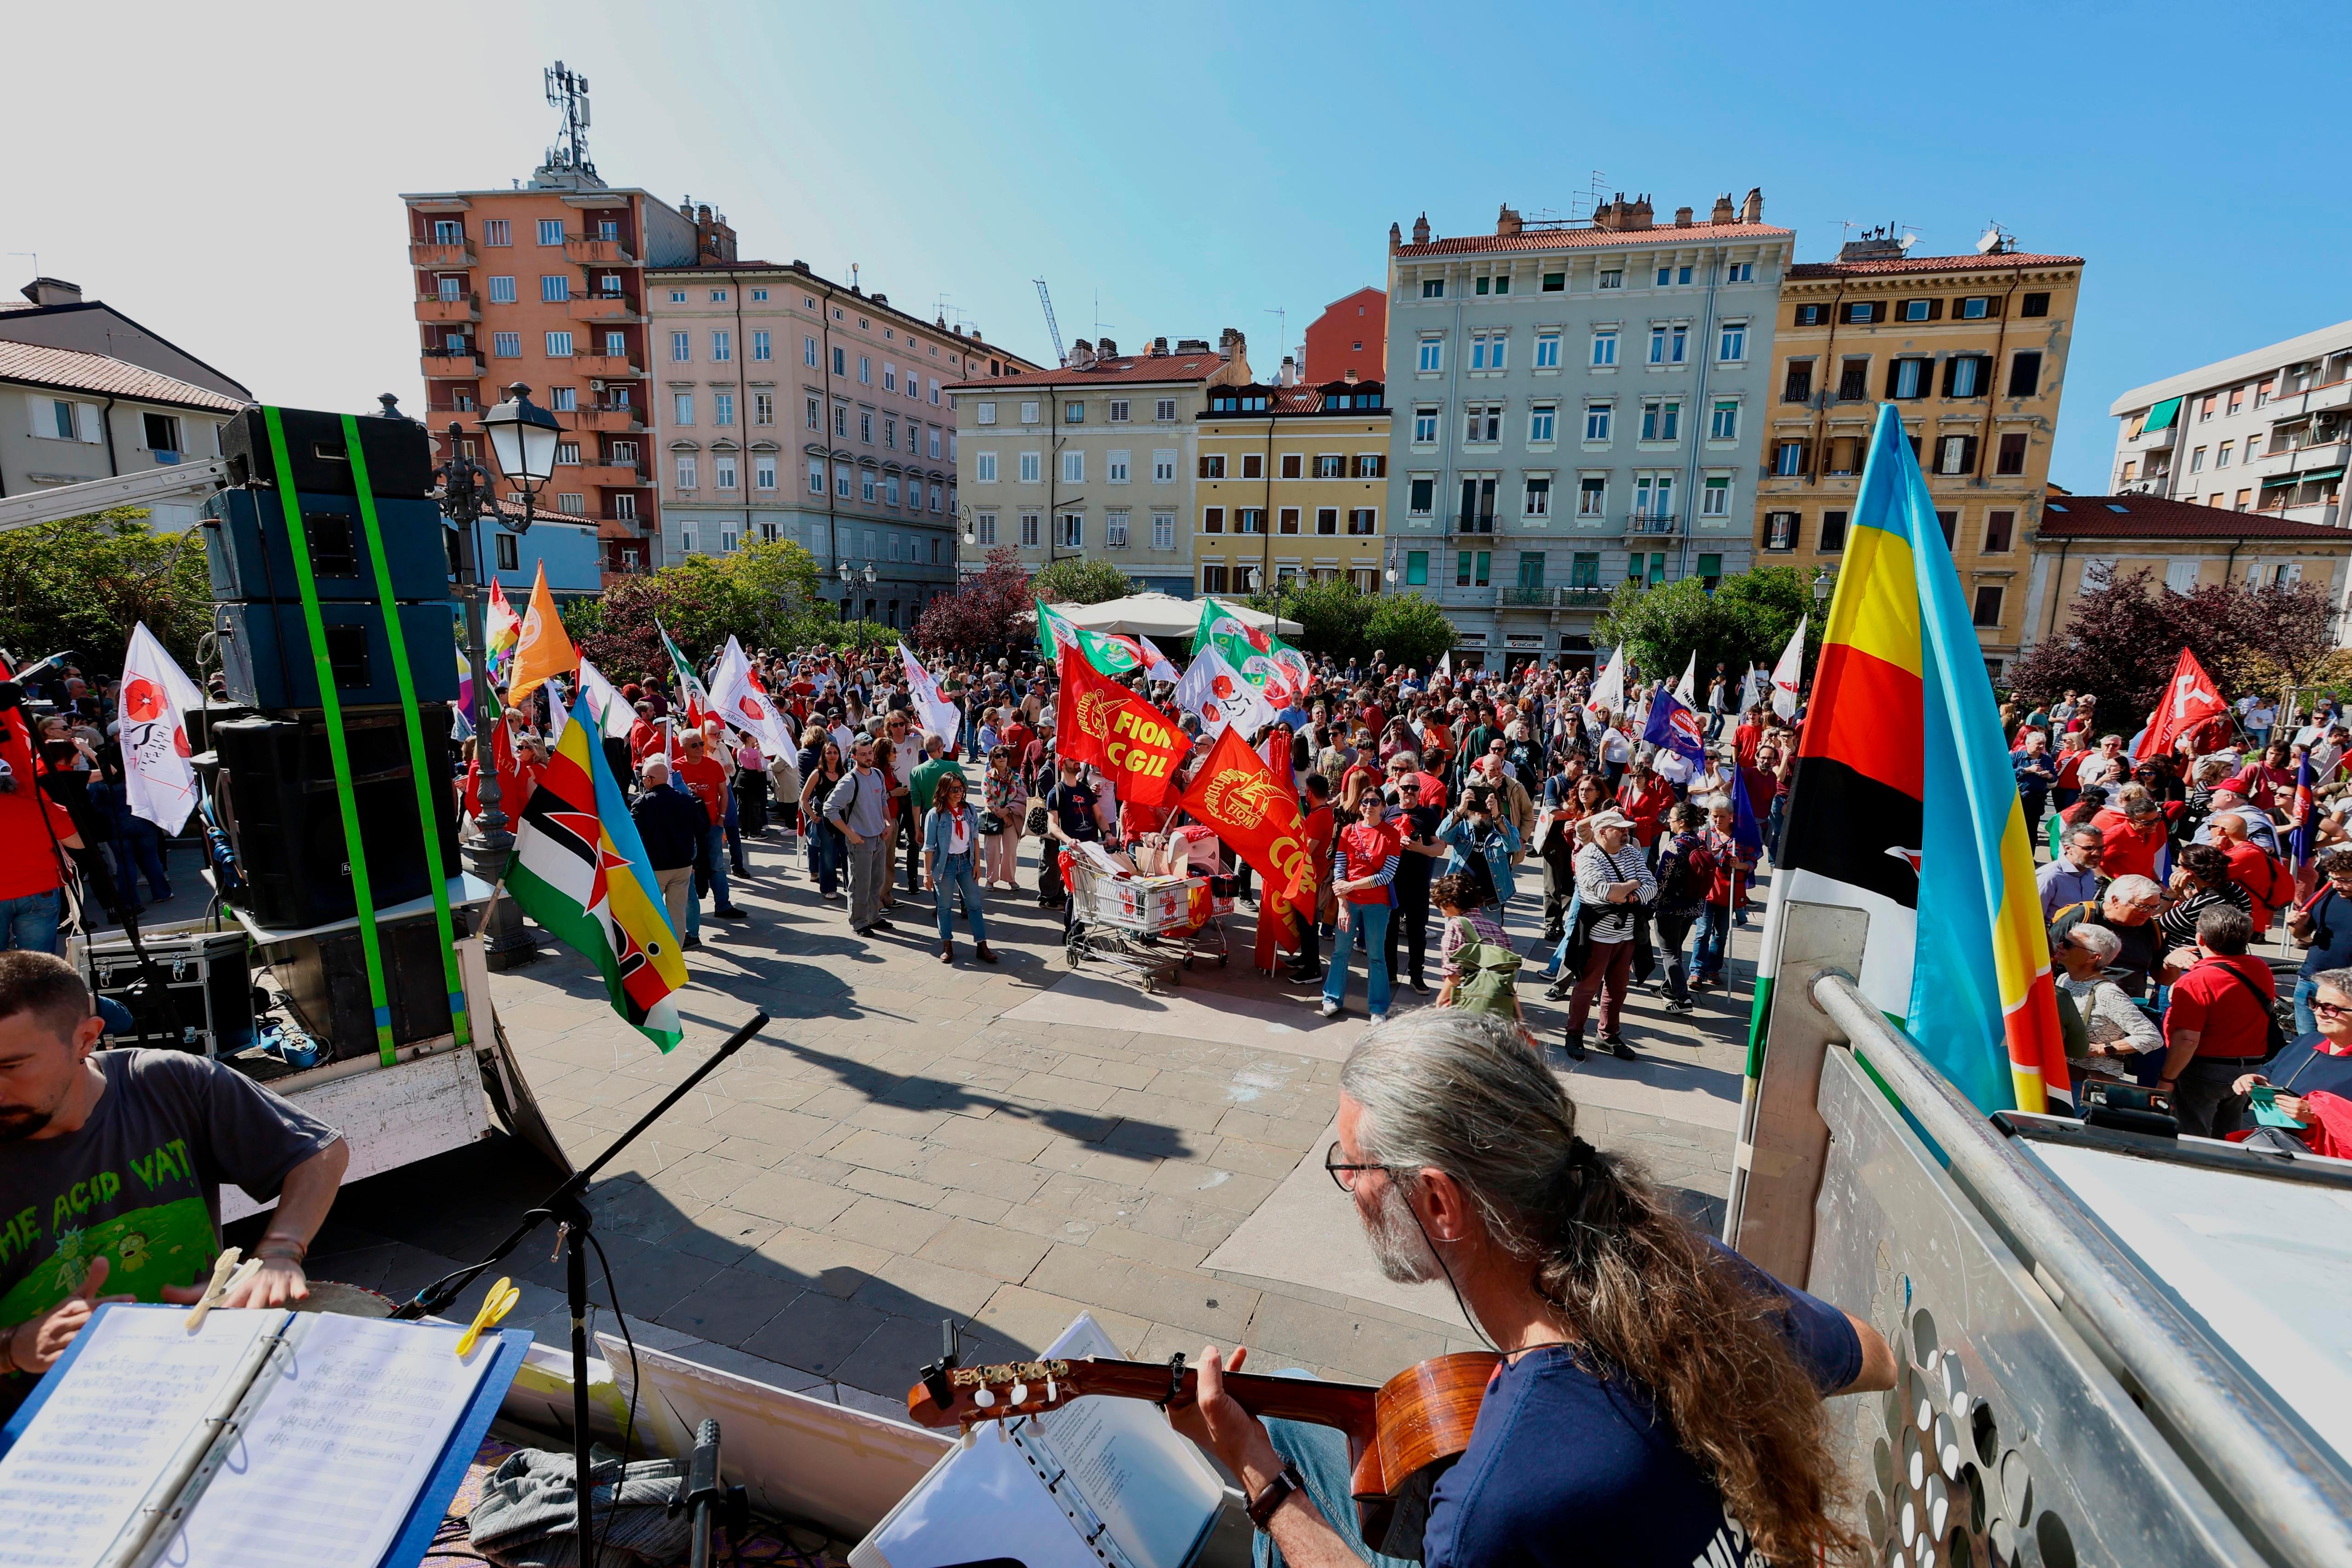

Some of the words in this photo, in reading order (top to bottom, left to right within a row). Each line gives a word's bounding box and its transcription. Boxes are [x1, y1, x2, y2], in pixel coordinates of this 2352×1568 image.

[1108, 742, 1168, 778] CGIL
[1227, 804, 1255, 827] FIOM
[52, 1172, 120, 1237] ACID
[129, 1138, 193, 1191] VAT
